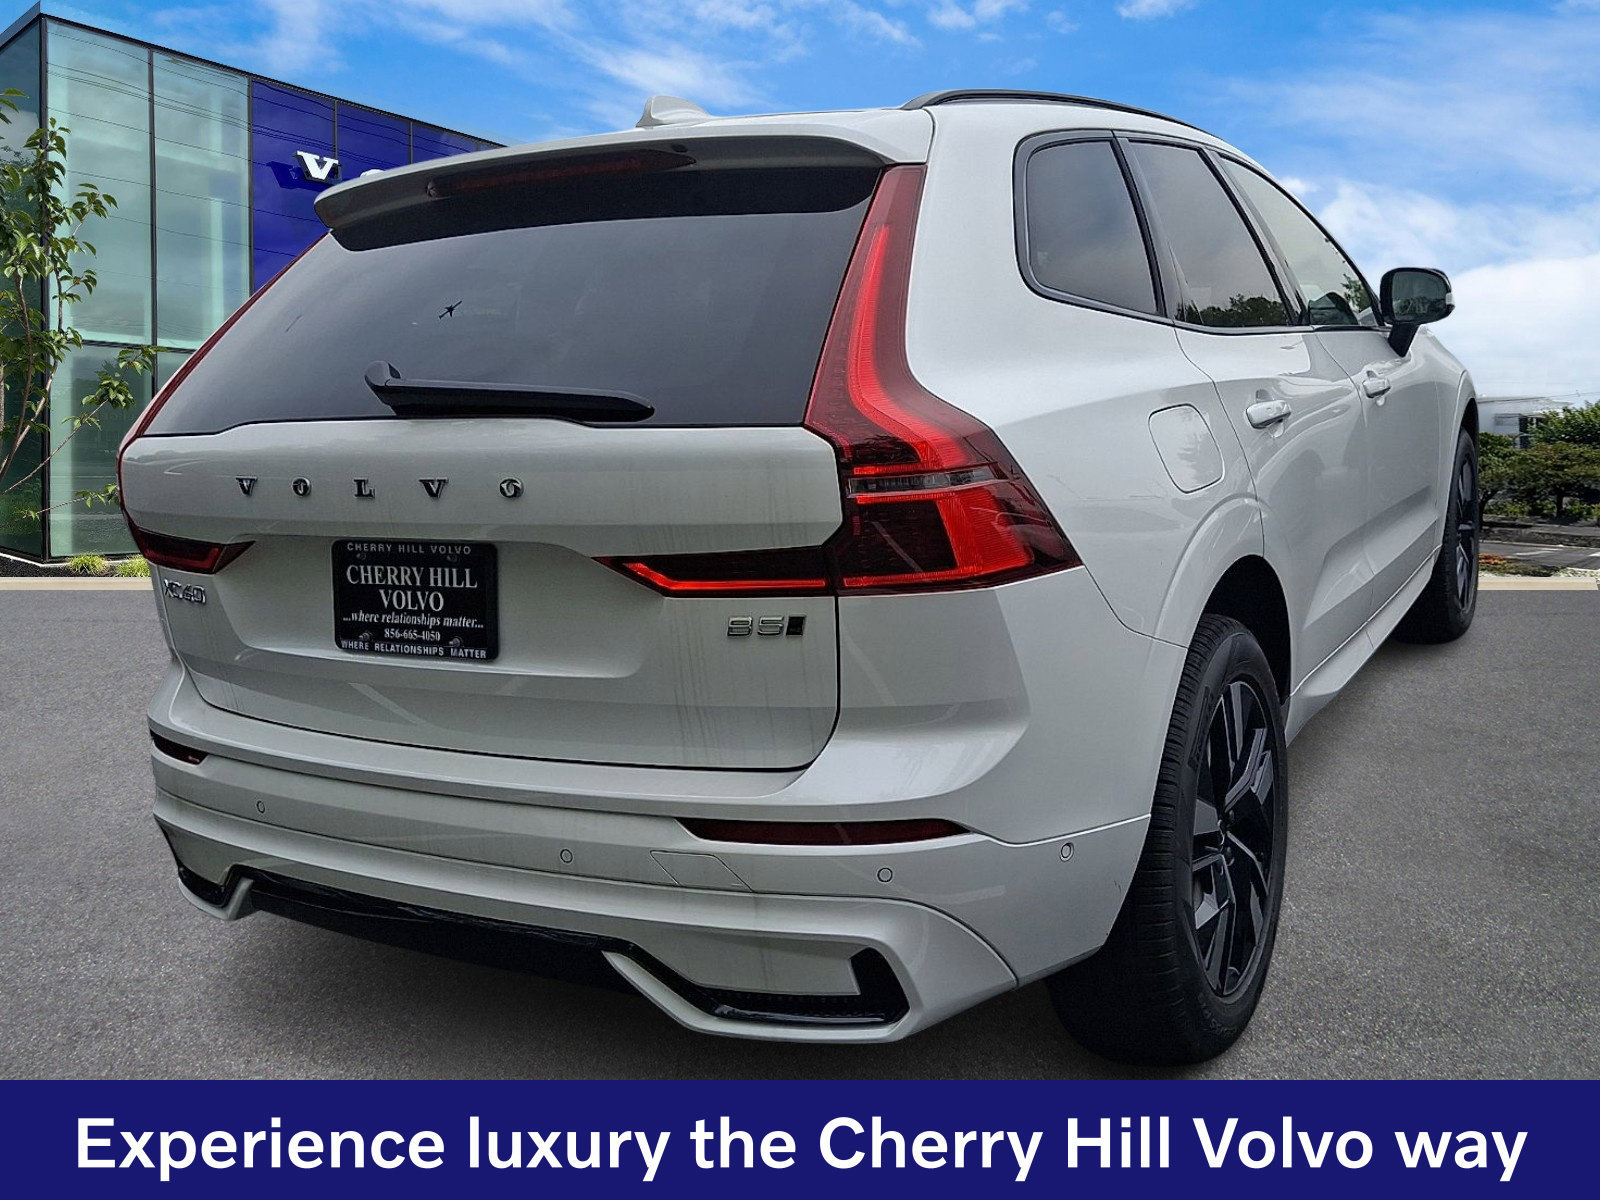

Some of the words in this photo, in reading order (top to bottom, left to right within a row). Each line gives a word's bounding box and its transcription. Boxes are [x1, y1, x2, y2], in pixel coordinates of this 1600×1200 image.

[235, 475, 525, 499] VOLVO
[347, 541, 393, 554] CHERRY
[398, 543, 425, 554] HILL
[430, 545, 472, 555] VOLVO
[346, 564, 425, 587] CHERRY
[429, 566, 478, 588] HILL
[379, 588, 445, 612] VOLVO
[342, 609, 380, 624] ...where
[381, 611, 441, 629] relationships
[443, 615, 484, 629] matter...
[384, 628, 441, 642] 856-665-4050
[340, 639, 370, 650] WHERE
[374, 641, 445, 657] RELATIONSHIPS
[450, 647, 487, 659] MATTER
